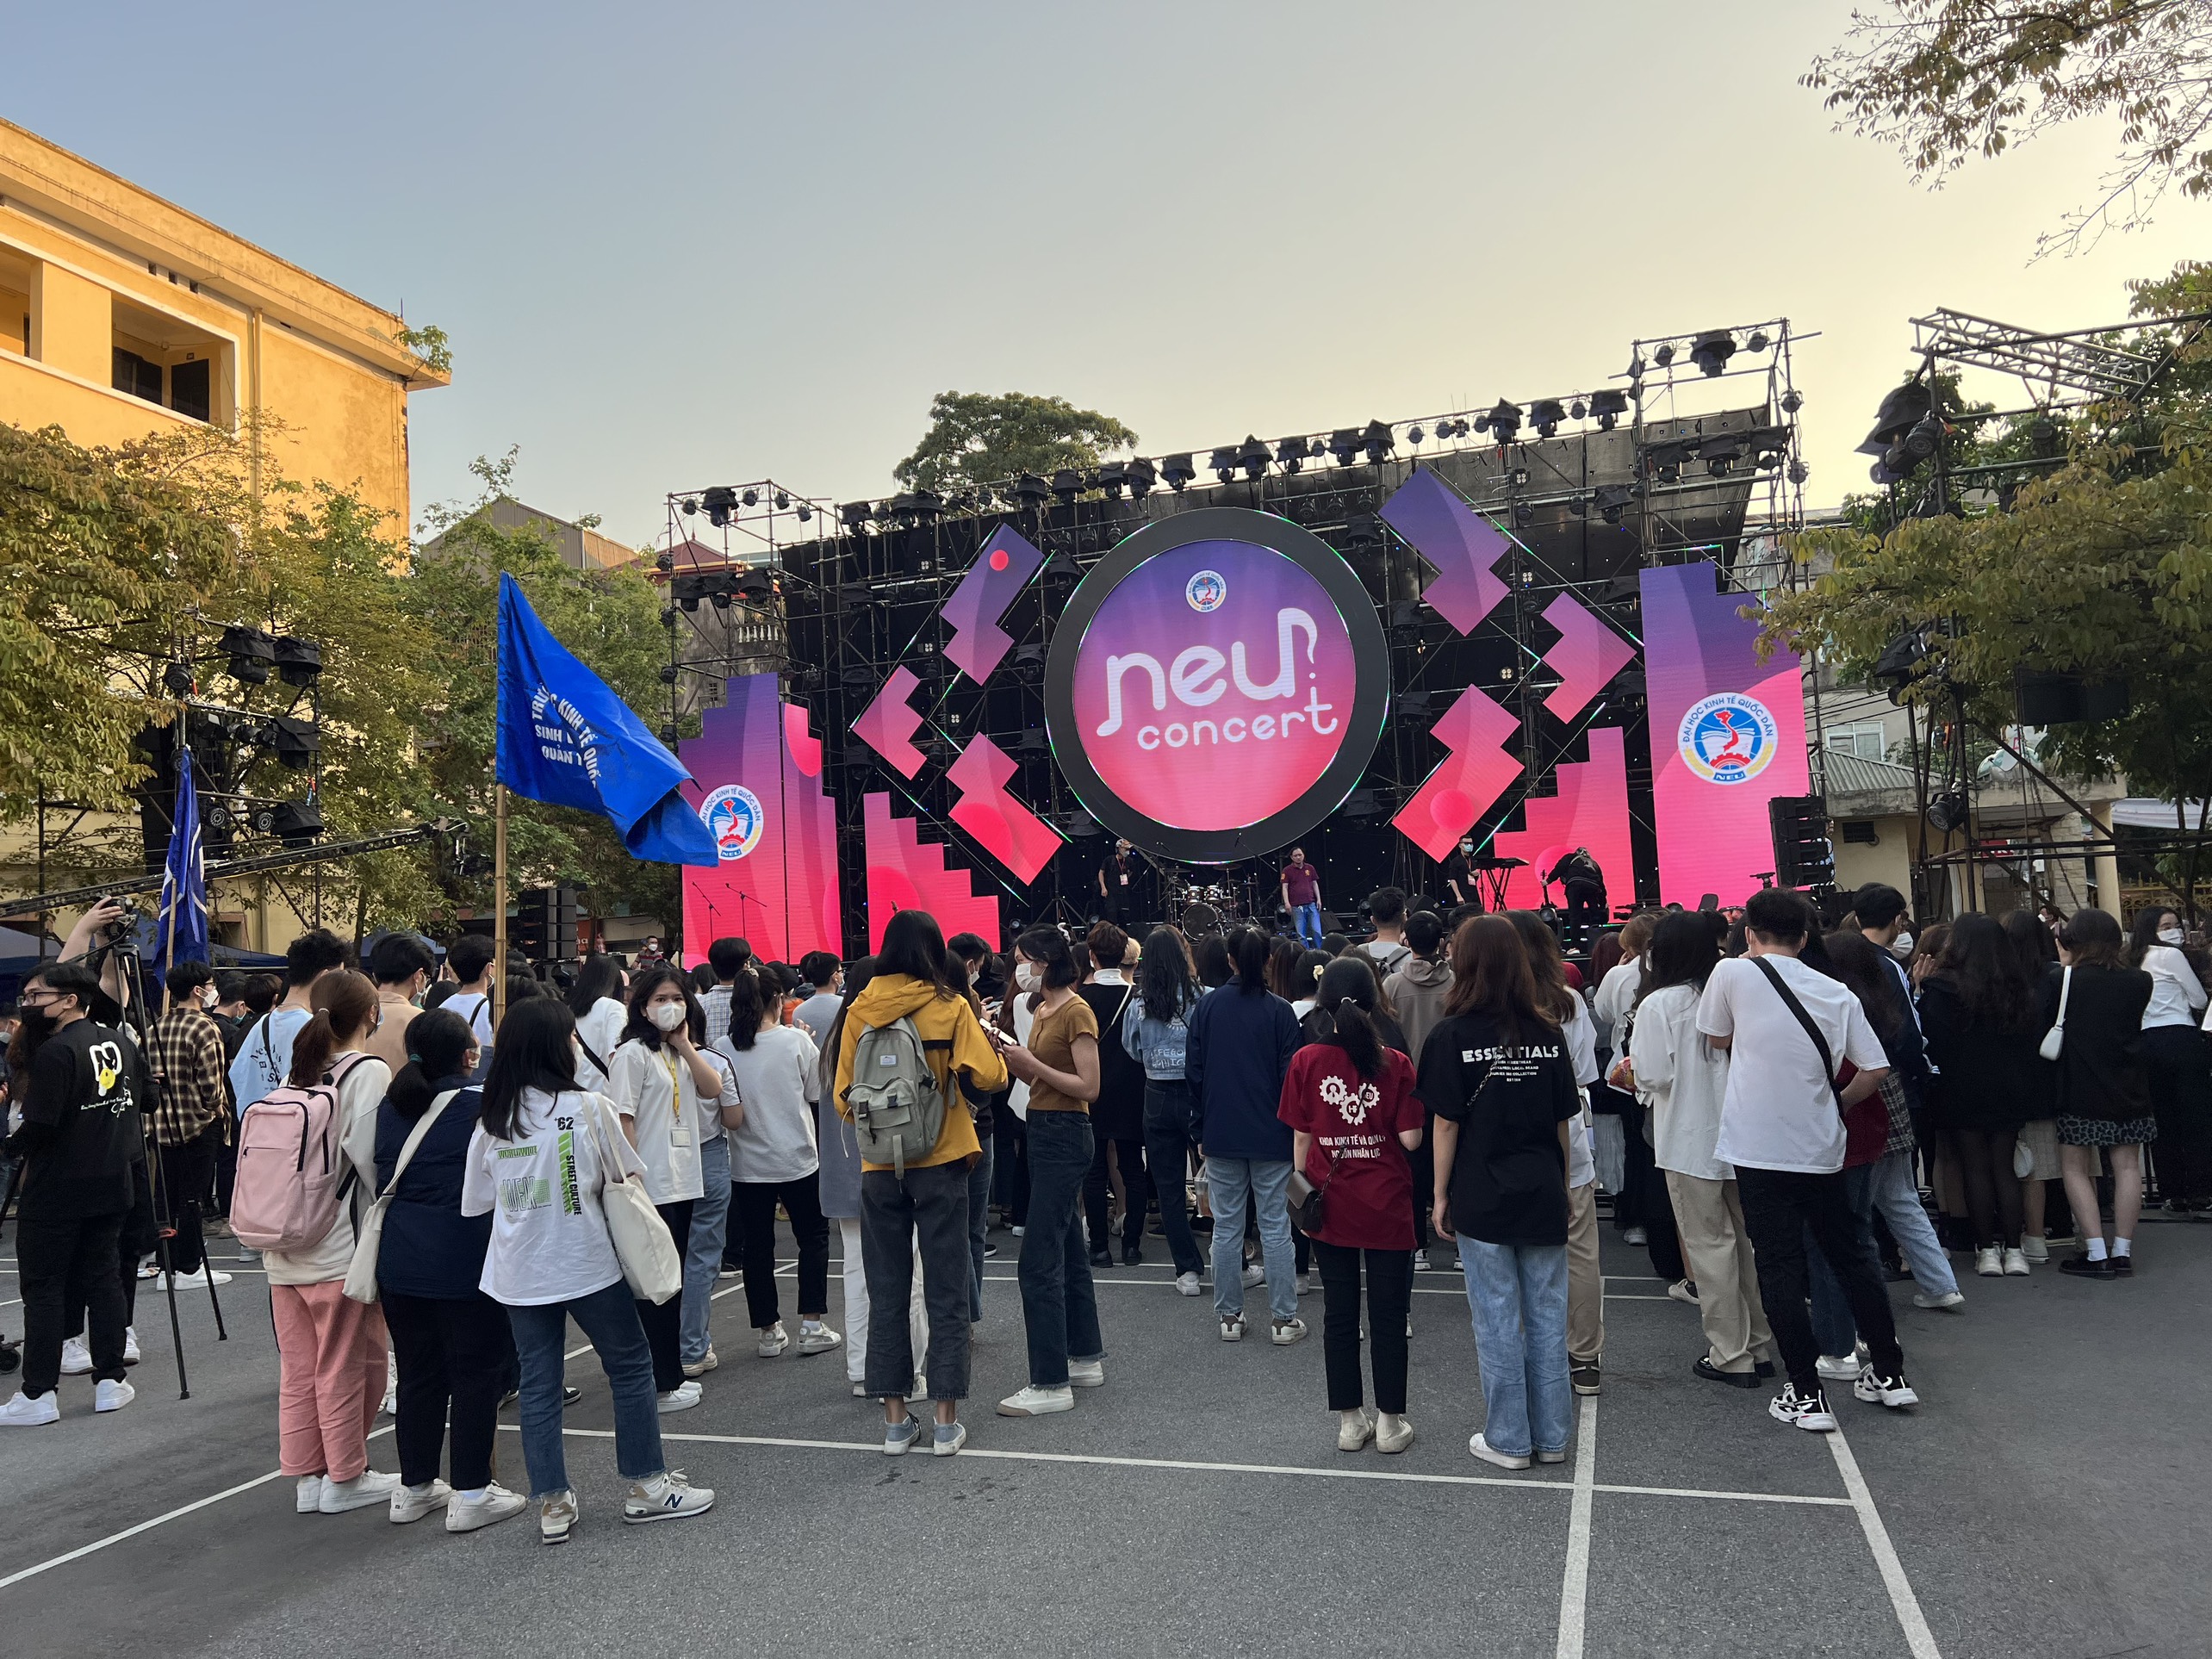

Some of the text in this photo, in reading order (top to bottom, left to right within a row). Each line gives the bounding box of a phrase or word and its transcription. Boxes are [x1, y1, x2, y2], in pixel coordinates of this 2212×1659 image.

[558, 699, 584, 730] KINH
[579, 726, 598, 748] TẾ
[1137, 687, 1338, 749] concert
[1682, 695, 1774, 743] ĐẠI HỌC KINH TẾ QUỐC DÂN
[535, 724, 562, 743] SINH
[541, 744, 573, 764] QUẢN
[1716, 772, 1744, 780] NEU
[716, 788, 730, 798] KINH
[737, 790, 755, 805] QUỐC
[1319, 1137, 1333, 1146] KHOA
[1334, 1136, 1349, 1146] KINH
[497, 1146, 537, 1159] WORLDWIDE
[1352, 1147, 1370, 1159] NHÂN
[566, 1155, 582, 1215] STREET CULTURE
[663, 1493, 683, 1509] N
